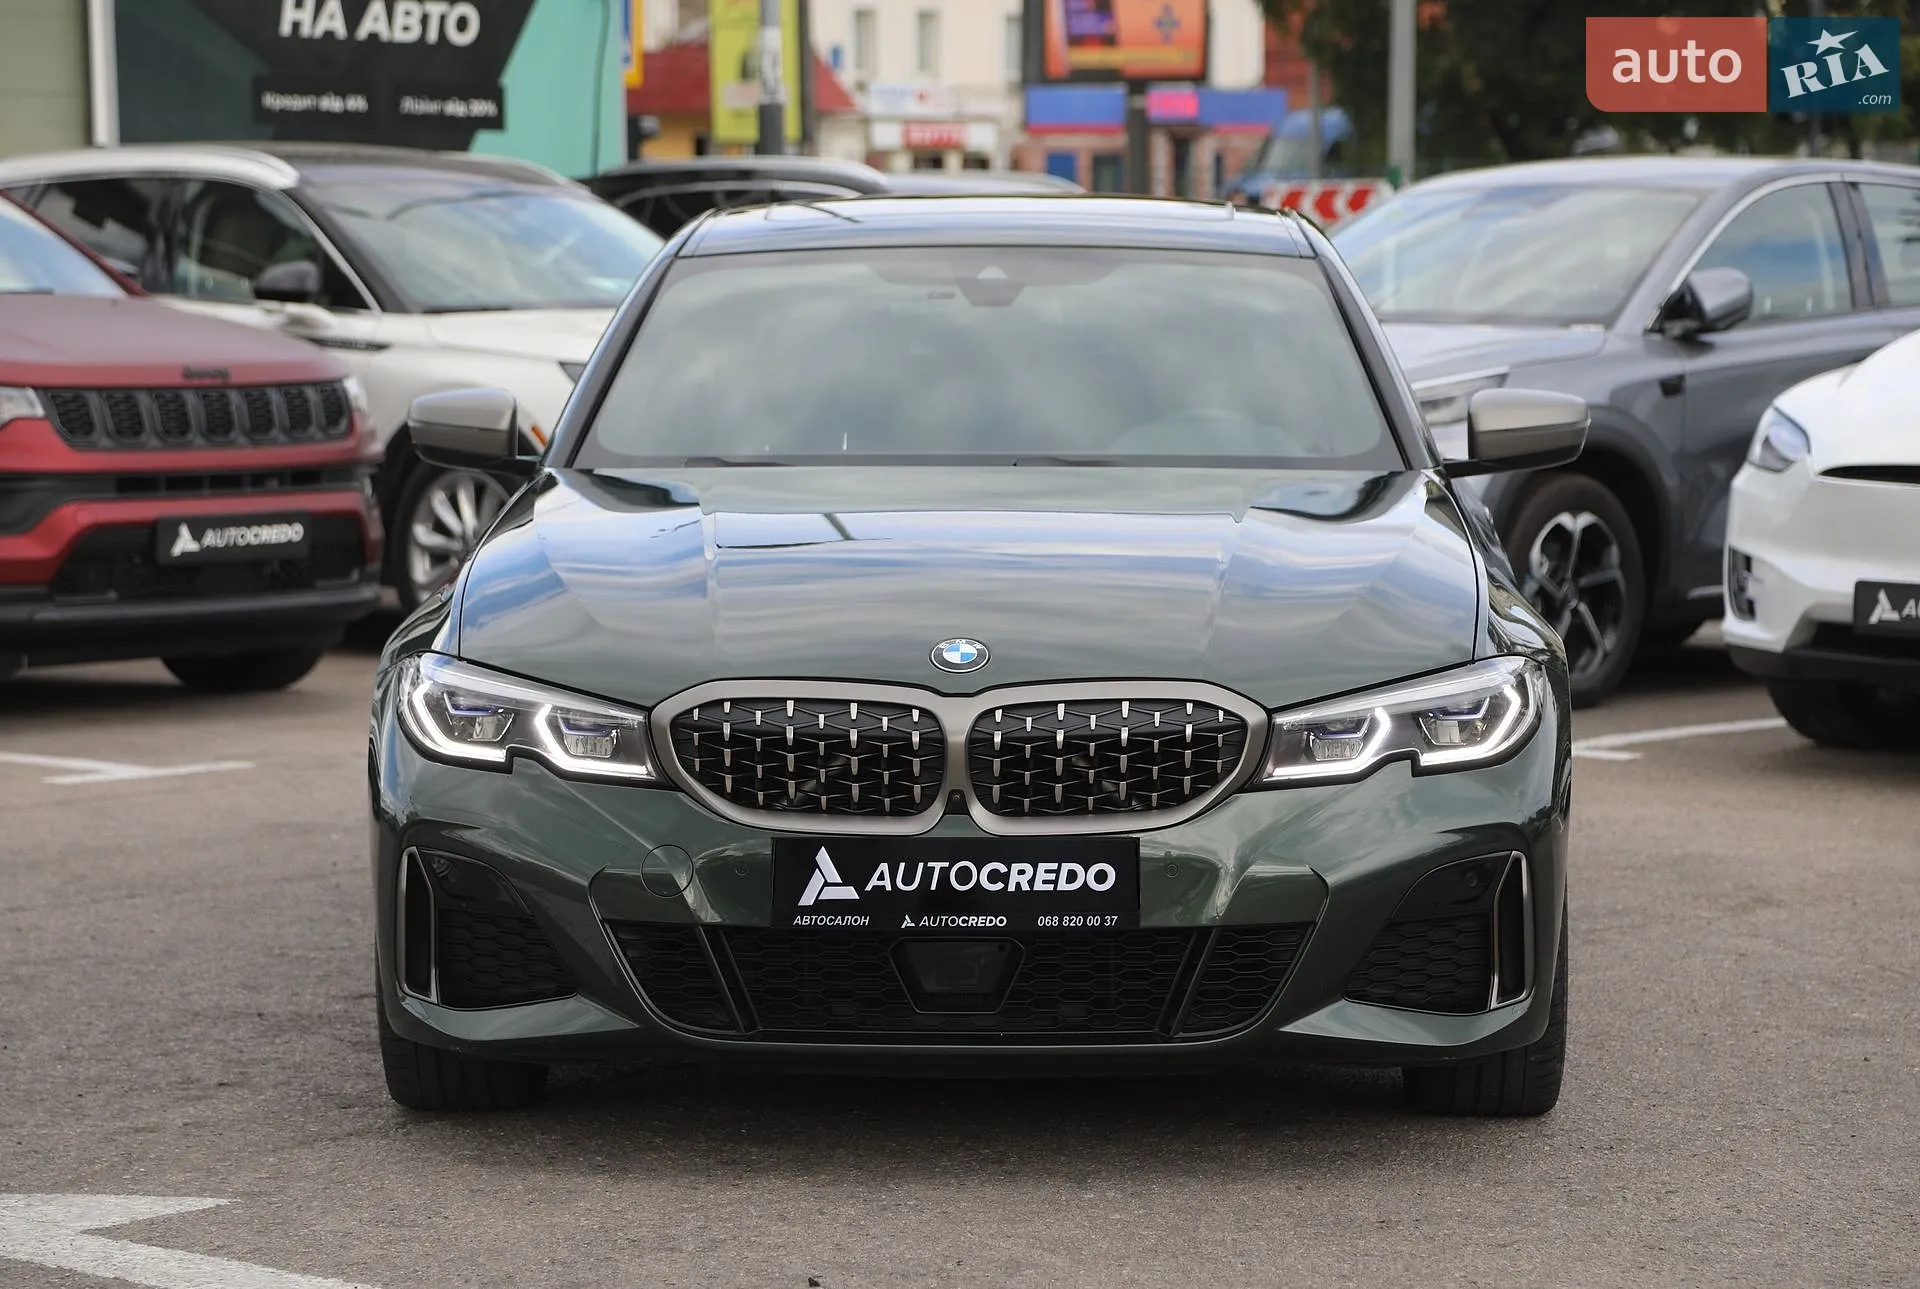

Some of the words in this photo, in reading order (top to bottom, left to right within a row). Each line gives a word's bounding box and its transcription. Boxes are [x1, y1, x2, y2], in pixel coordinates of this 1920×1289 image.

[279, 0, 348, 40] НА
[355, 0, 480, 47] АВТО
[200, 522, 304, 548] AUTOCREDO
[865, 860, 1116, 892] AUTOCREDO
[793, 915, 870, 926] АВТОСАЛОН
[919, 915, 1008, 927] AUTOCREDO
[1037, 915, 1060, 927] 068
[1062, 915, 1084, 927] 820
[1086, 915, 1101, 927] 00
[1103, 915, 1119, 927] 37
